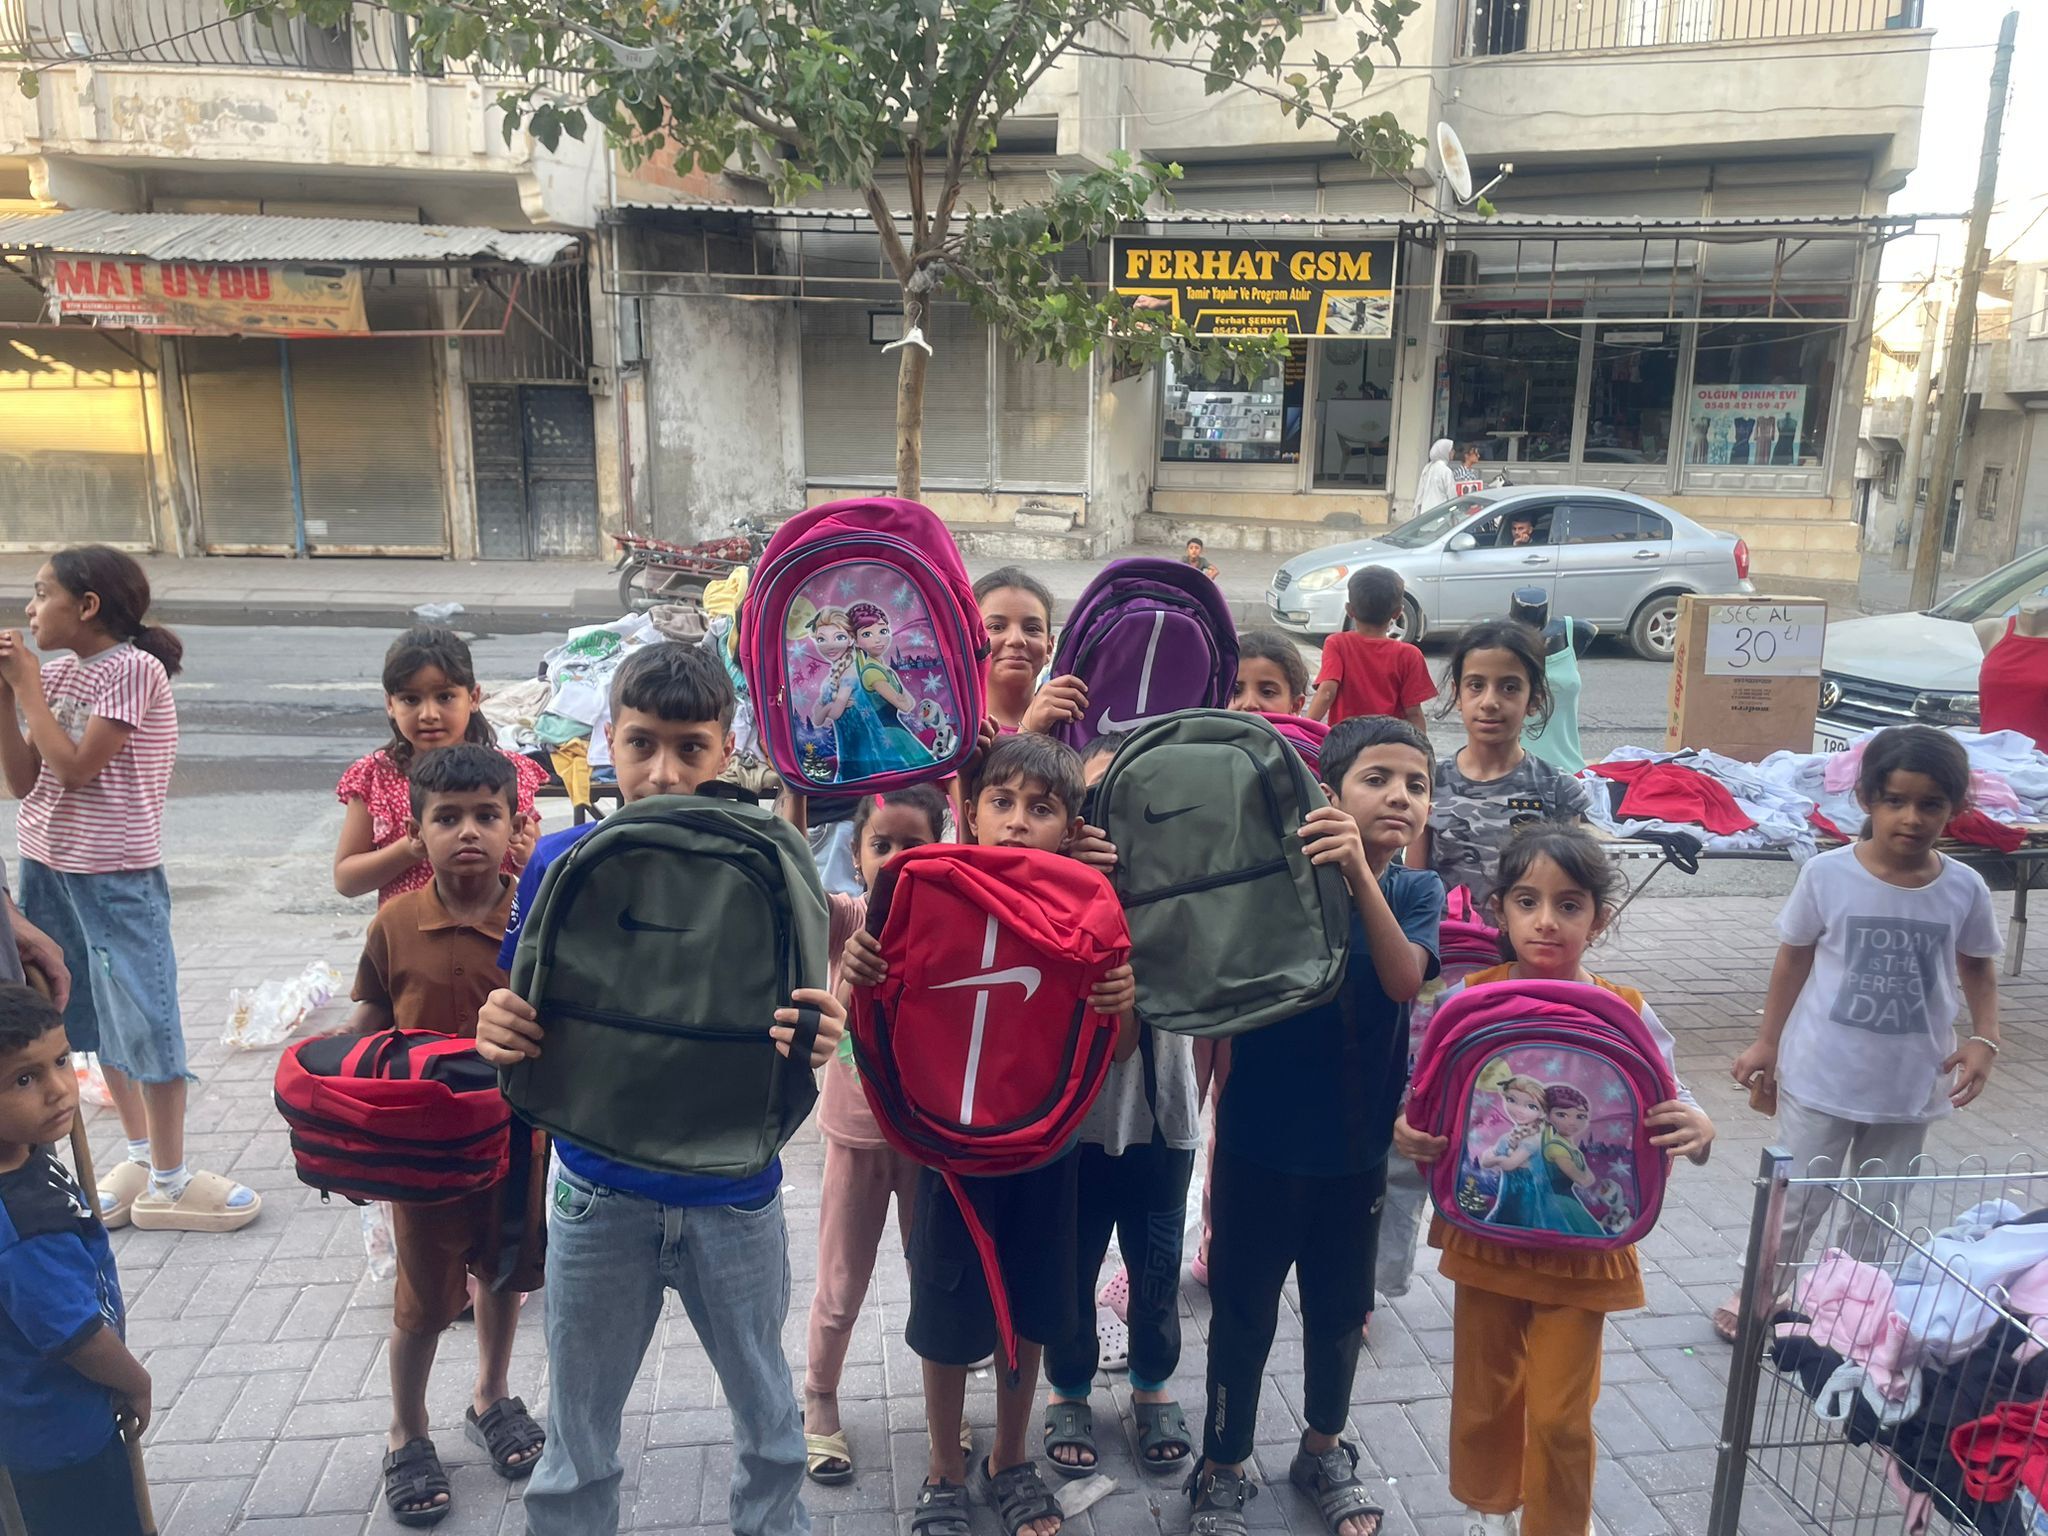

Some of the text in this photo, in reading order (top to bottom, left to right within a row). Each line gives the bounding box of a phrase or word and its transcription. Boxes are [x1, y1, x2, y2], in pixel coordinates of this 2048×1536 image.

[1125, 249, 1373, 281] FERHAT GSM
[54, 260, 271, 301] MAT UYDU
[1186, 286, 1210, 300] Tamir
[1240, 286, 1250, 300] Ve
[1251, 286, 1288, 304] Program
[1215, 316, 1246, 325] Ferhat
[1698, 391, 1738, 400] OLGUN
[1769, 606, 1793, 622] AL
[1728, 627, 1777, 668] 30
[1856, 927, 1940, 954] TODAY
[1884, 954, 1921, 974] THE
[1847, 972, 1923, 996] PERFEC
[1849, 994, 1926, 1029] DAY
